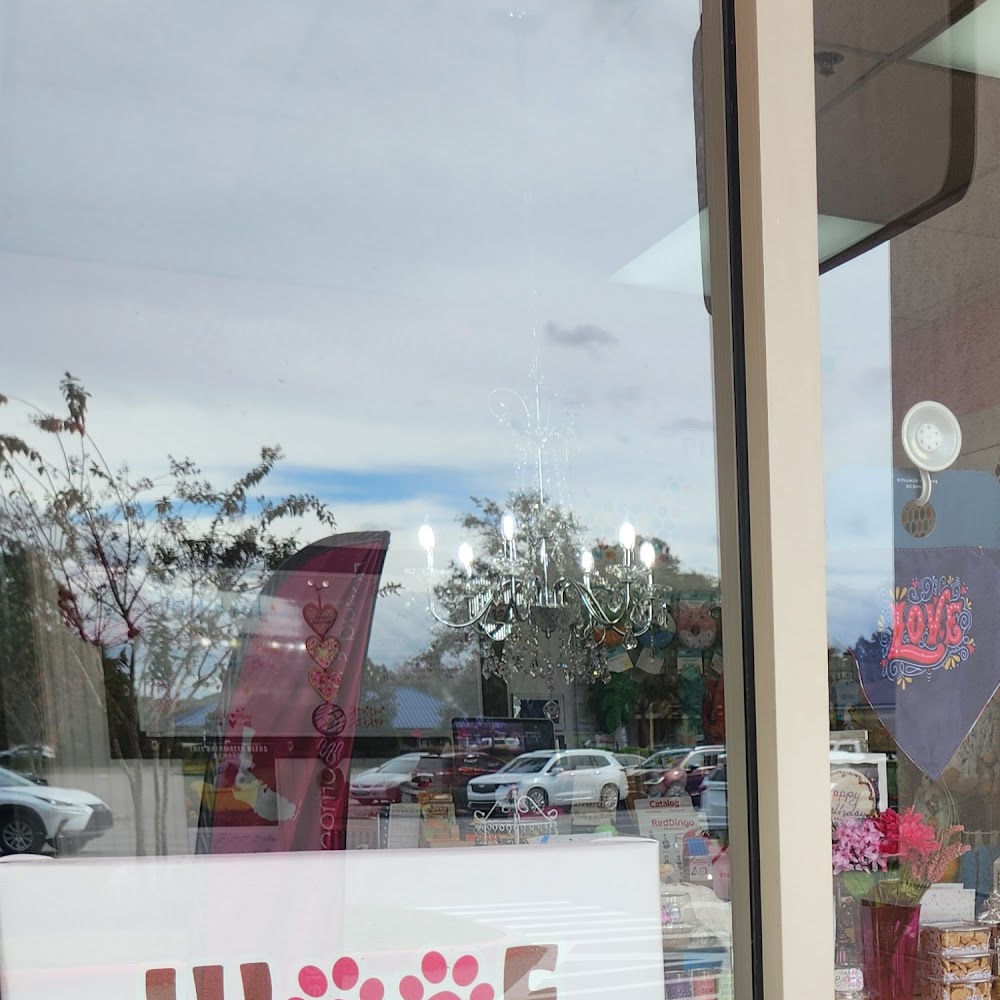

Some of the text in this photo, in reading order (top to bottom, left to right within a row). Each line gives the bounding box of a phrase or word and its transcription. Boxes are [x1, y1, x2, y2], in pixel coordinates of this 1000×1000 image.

[888, 588, 965, 665] LOVE
[650, 800, 680, 809] Catalog
[651, 818, 695, 828] RedDingo
